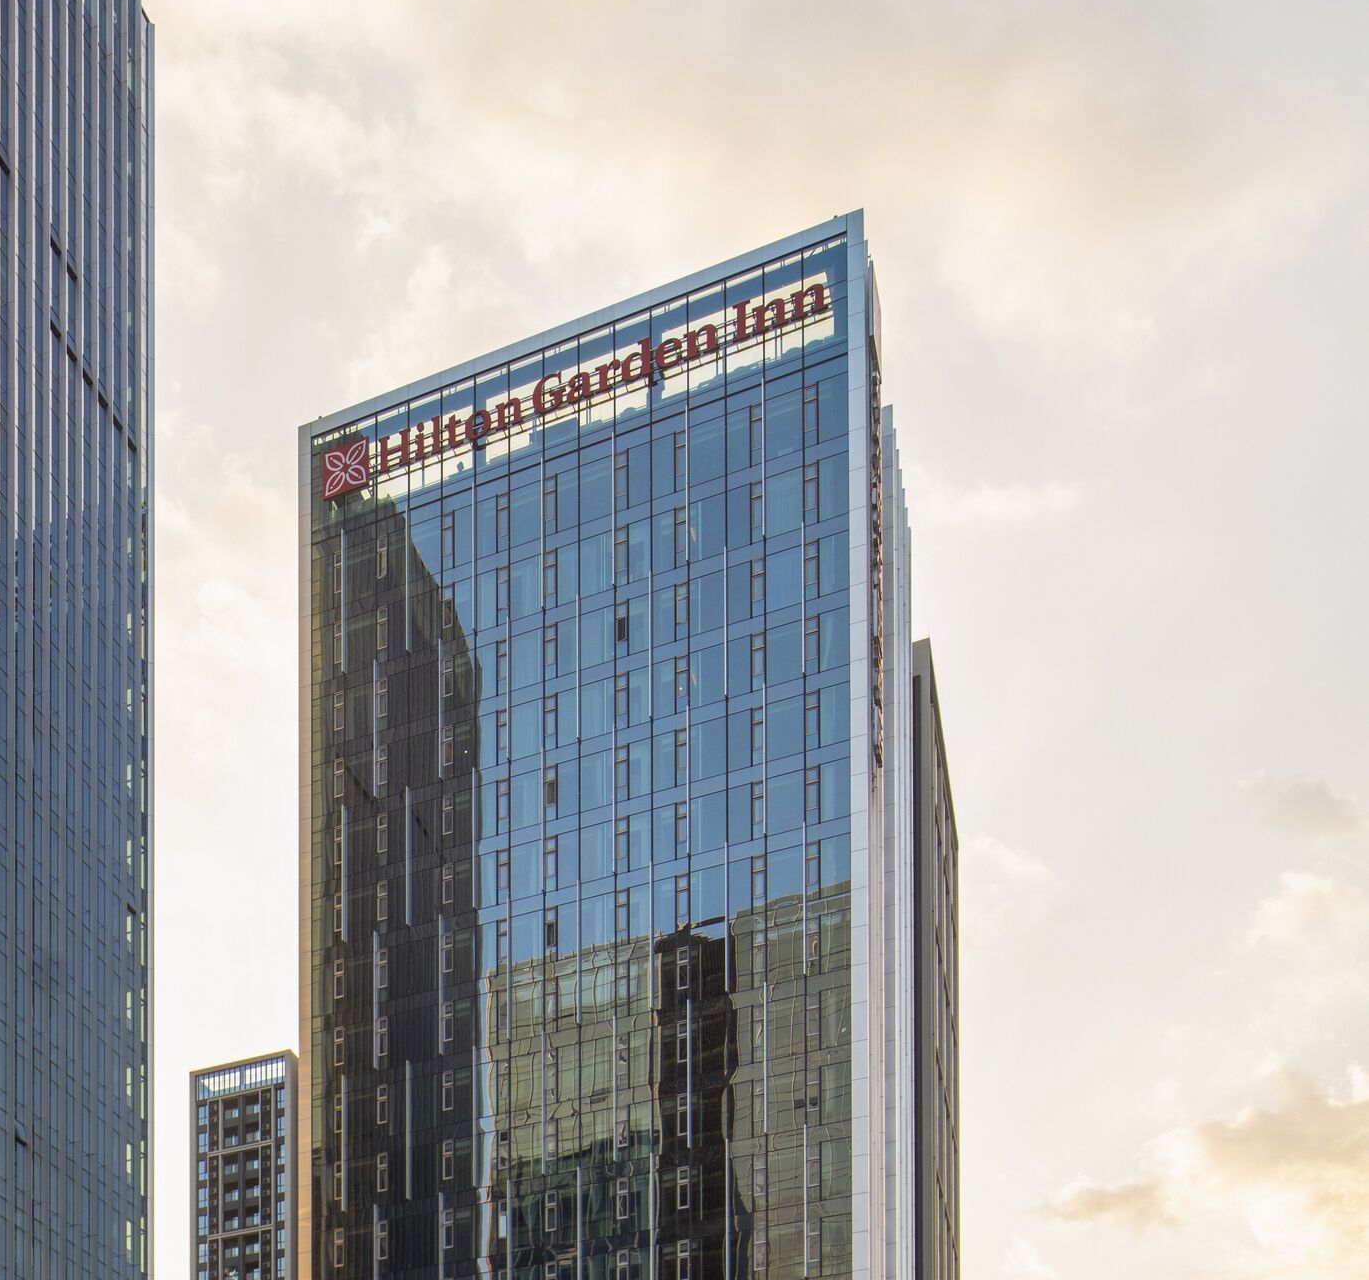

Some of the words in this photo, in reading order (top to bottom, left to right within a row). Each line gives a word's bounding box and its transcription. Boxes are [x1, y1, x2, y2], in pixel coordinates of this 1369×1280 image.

[378, 398, 521, 474] Hilton
[532, 323, 719, 415] Garden
[732, 281, 828, 341] Inn
